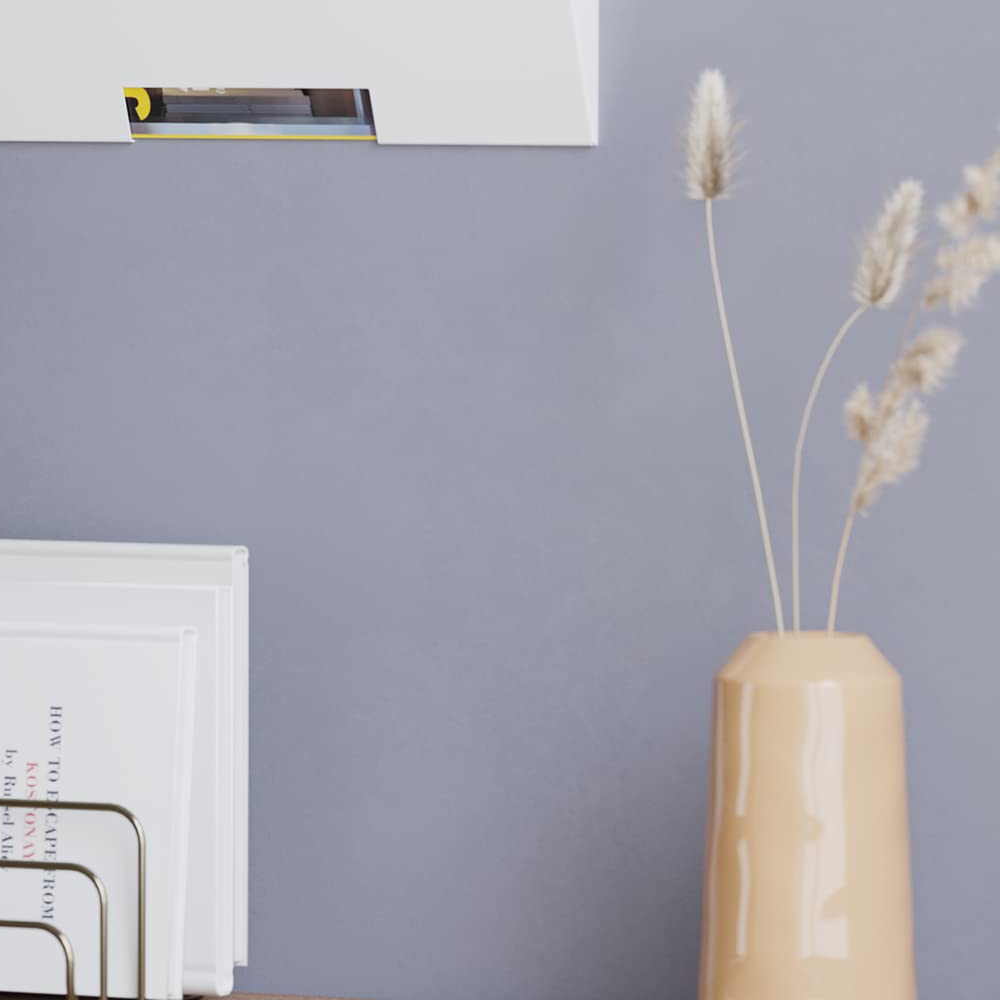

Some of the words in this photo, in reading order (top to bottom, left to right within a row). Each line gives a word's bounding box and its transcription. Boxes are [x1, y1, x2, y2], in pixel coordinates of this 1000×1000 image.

[49, 706, 62, 748] HOW
[1, 749, 17, 767] by
[47, 757, 60, 783] TO
[22, 762, 39, 861] KOSONAY
[44, 791, 59, 862] ECAPE
[41, 868, 56, 919] FROM
